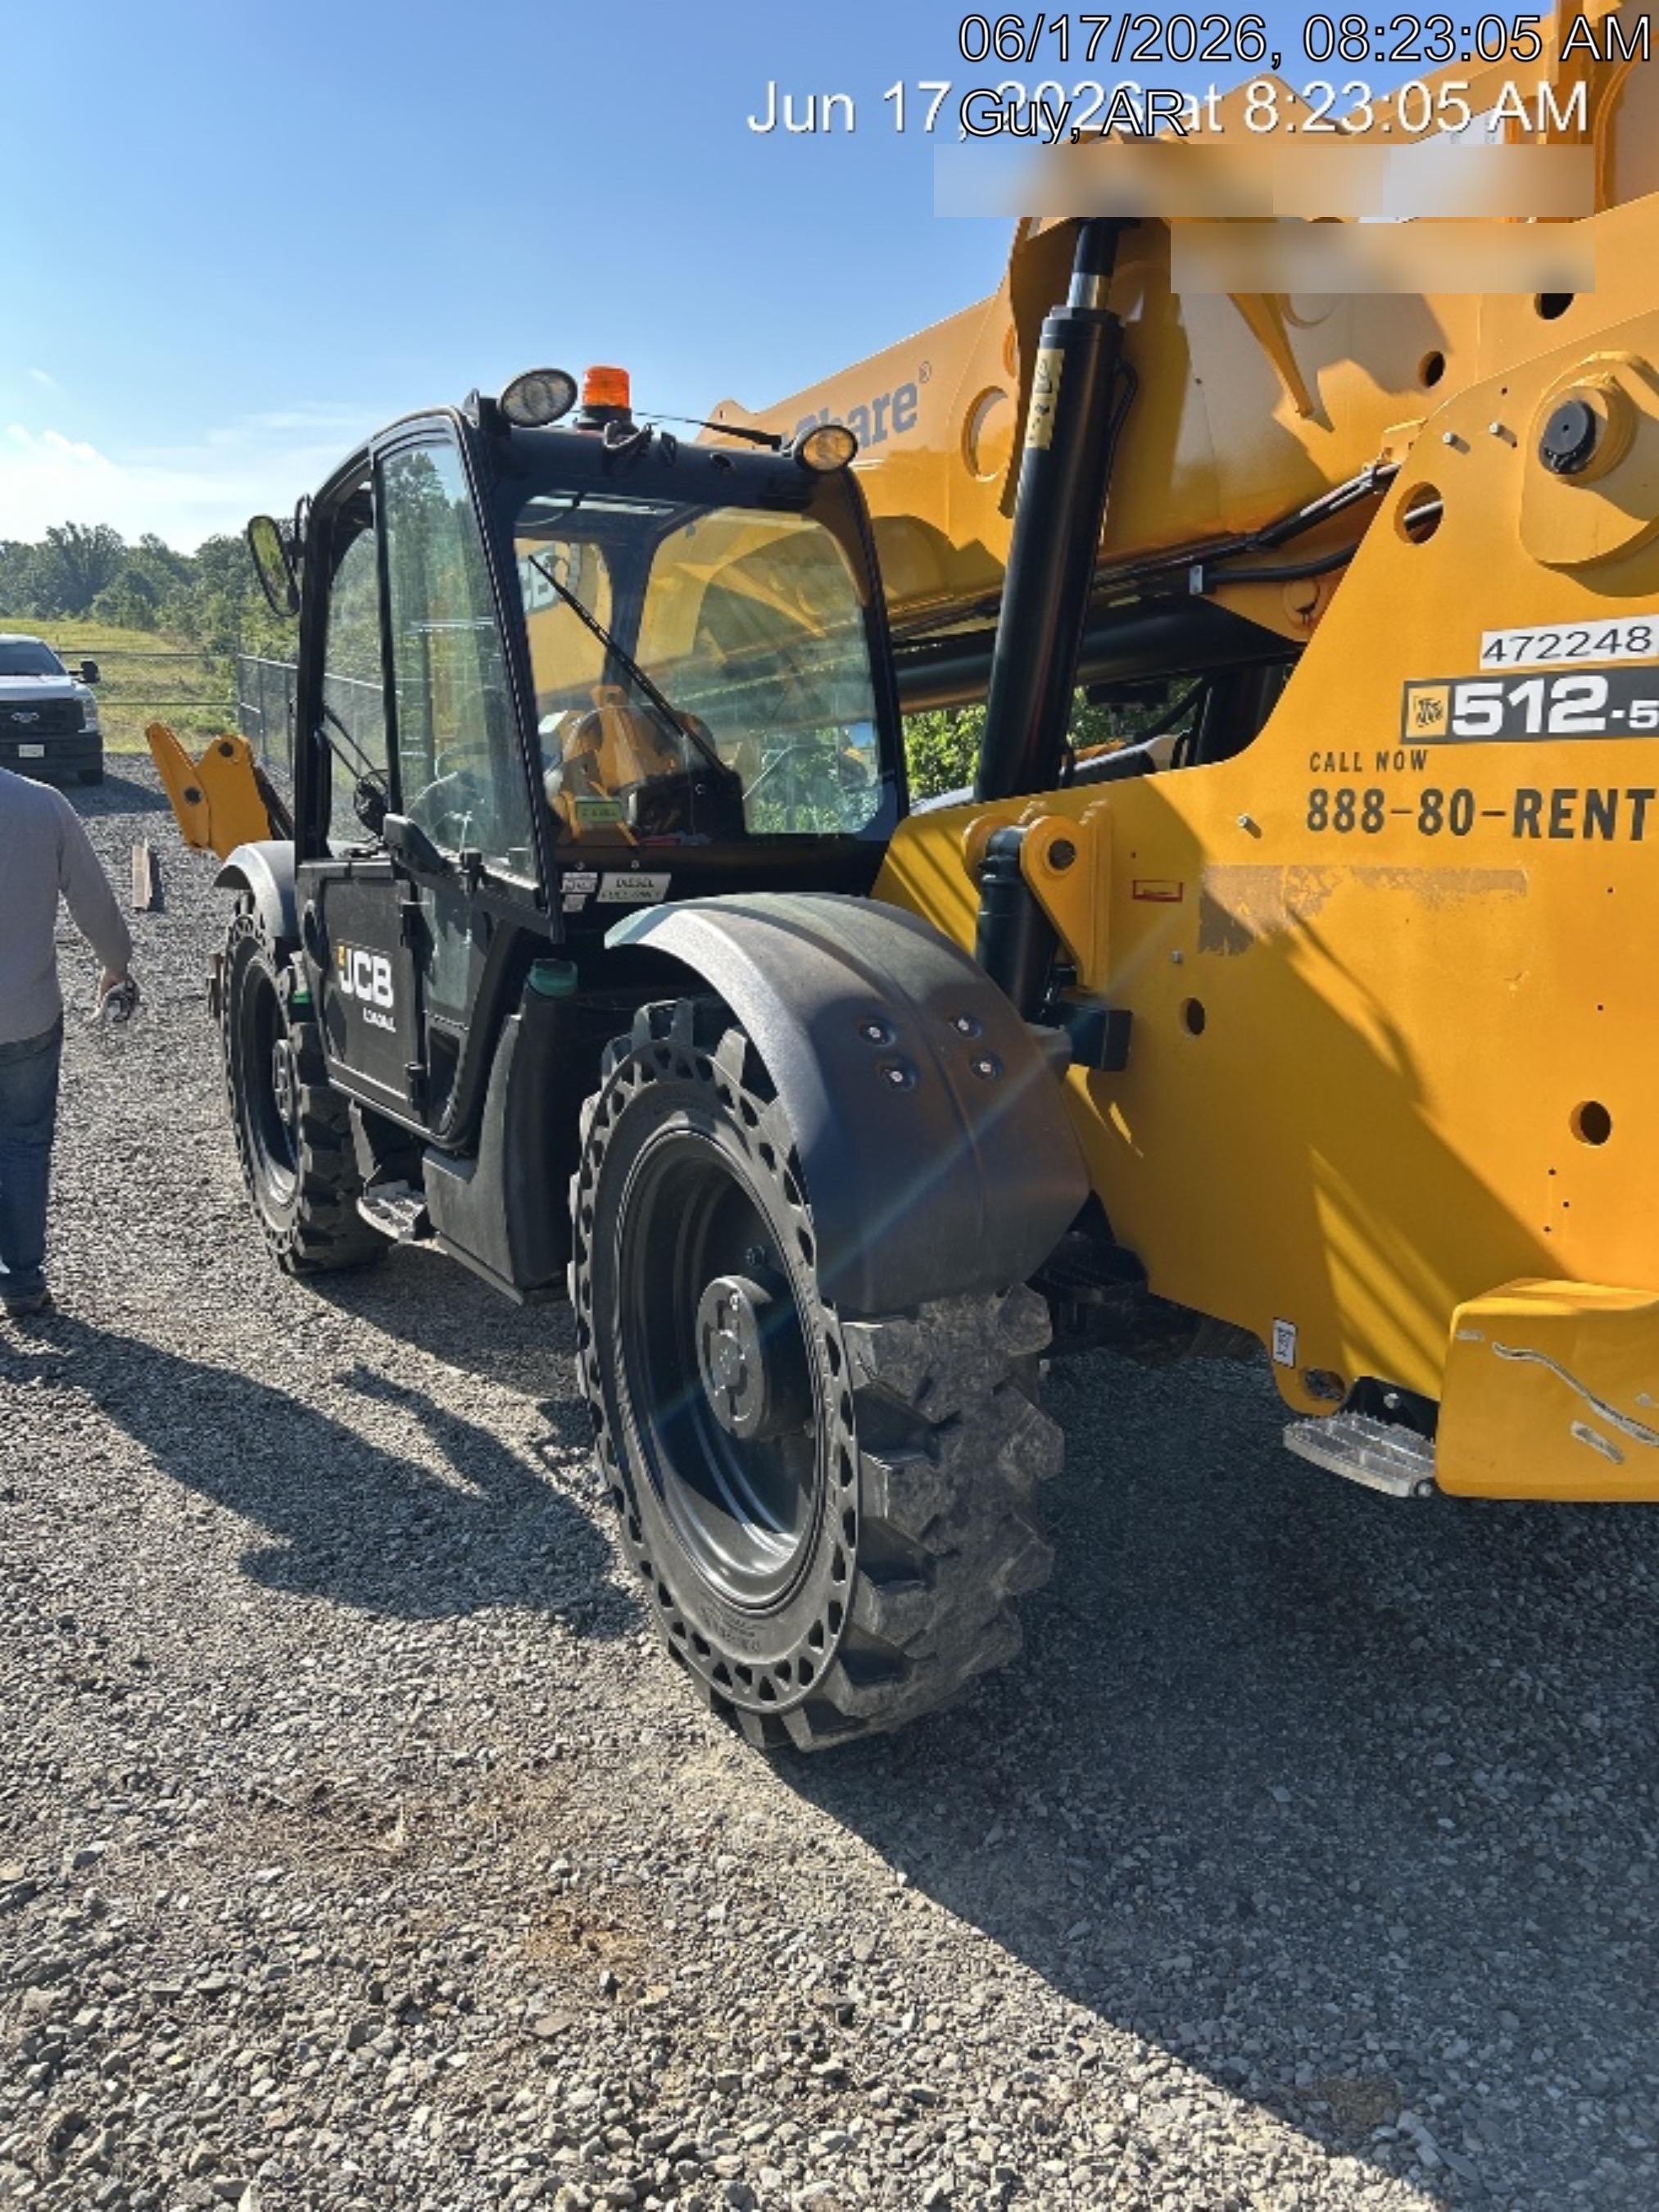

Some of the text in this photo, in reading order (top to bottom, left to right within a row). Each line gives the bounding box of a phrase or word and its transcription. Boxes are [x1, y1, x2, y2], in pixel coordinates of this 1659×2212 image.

[1482, 625, 1652, 663] 472248
[1309, 749, 1429, 773] CALL NOW
[1307, 787, 1657, 841] 888-80-RENT
[338, 943, 394, 1009] JCB
